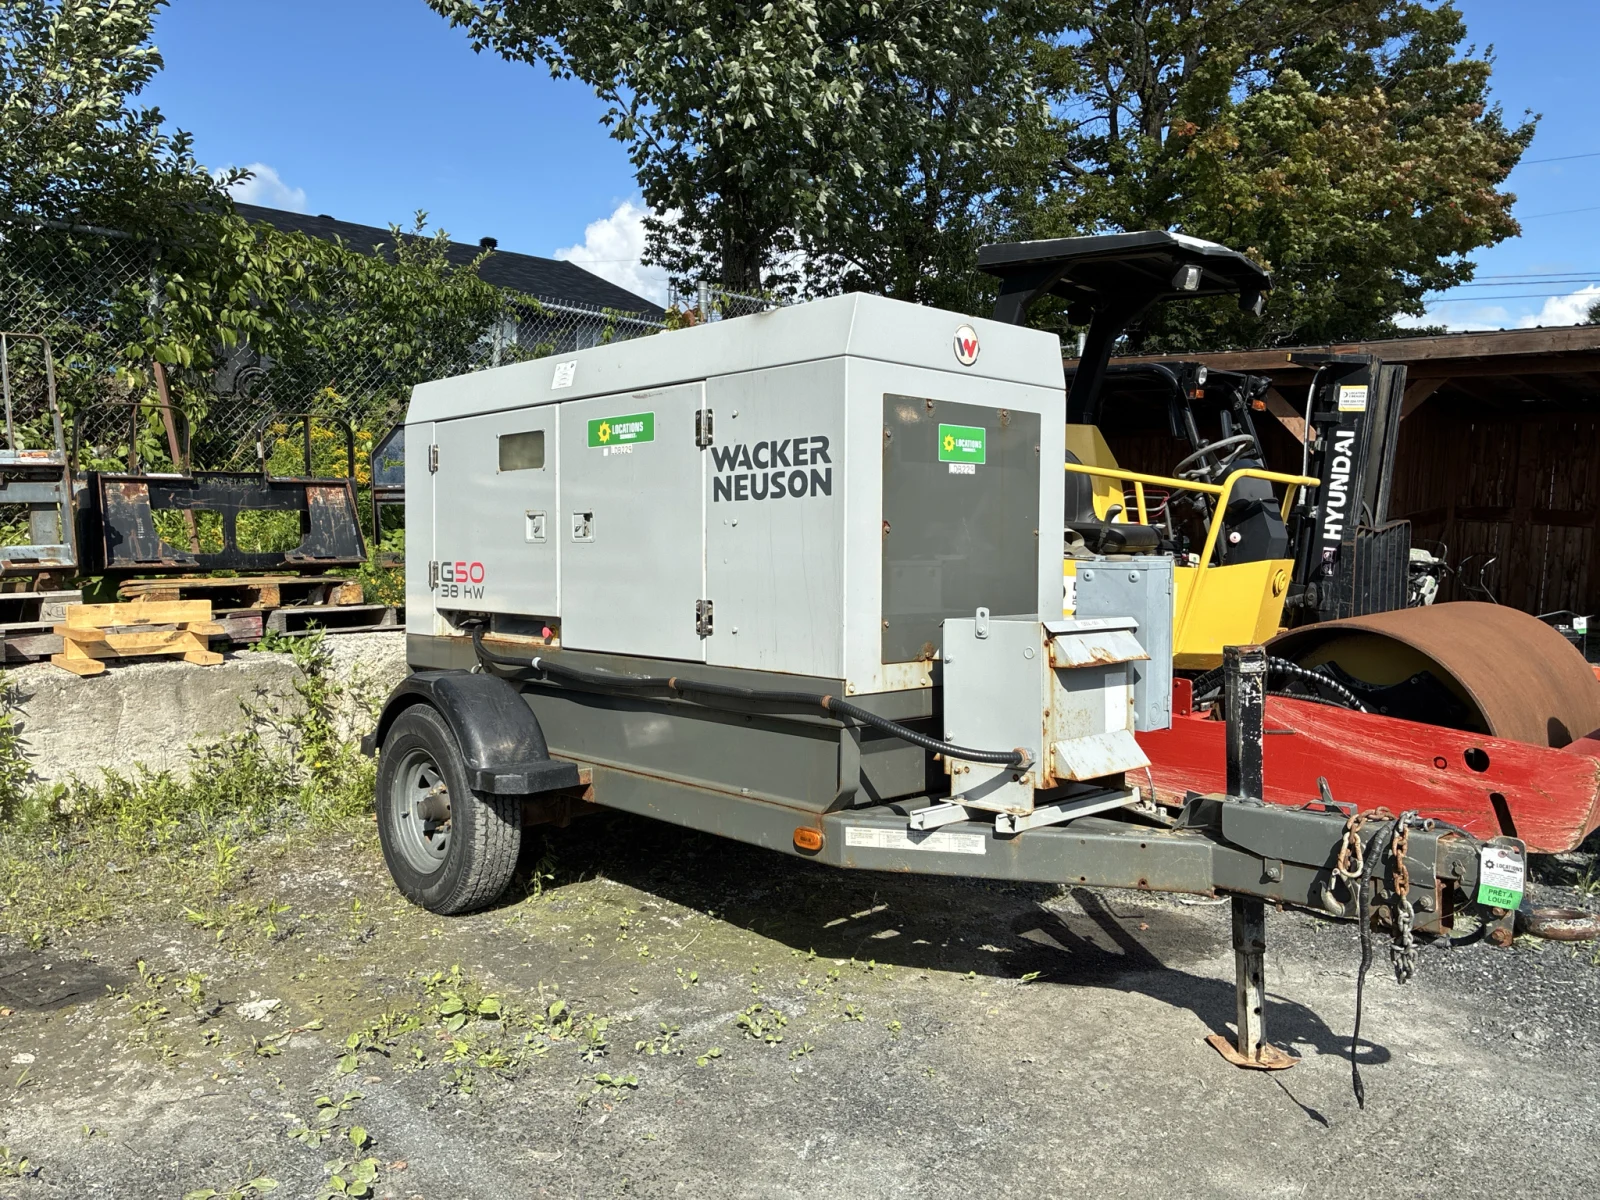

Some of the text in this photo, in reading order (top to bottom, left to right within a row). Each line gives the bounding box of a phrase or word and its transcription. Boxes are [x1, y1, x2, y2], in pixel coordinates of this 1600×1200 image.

[612, 421, 643, 434] LOCATIONS
[956, 438, 982, 449] LOCATIONS
[711, 435, 832, 472] WACKER
[713, 467, 832, 502] NEUSON
[1322, 430, 1355, 540] HYUNDAI
[441, 561, 485, 583] G50
[441, 584, 459, 598] 38
[1496, 862, 1523, 874] LOCATIONS
[1487, 896, 1512, 905] LOUER
